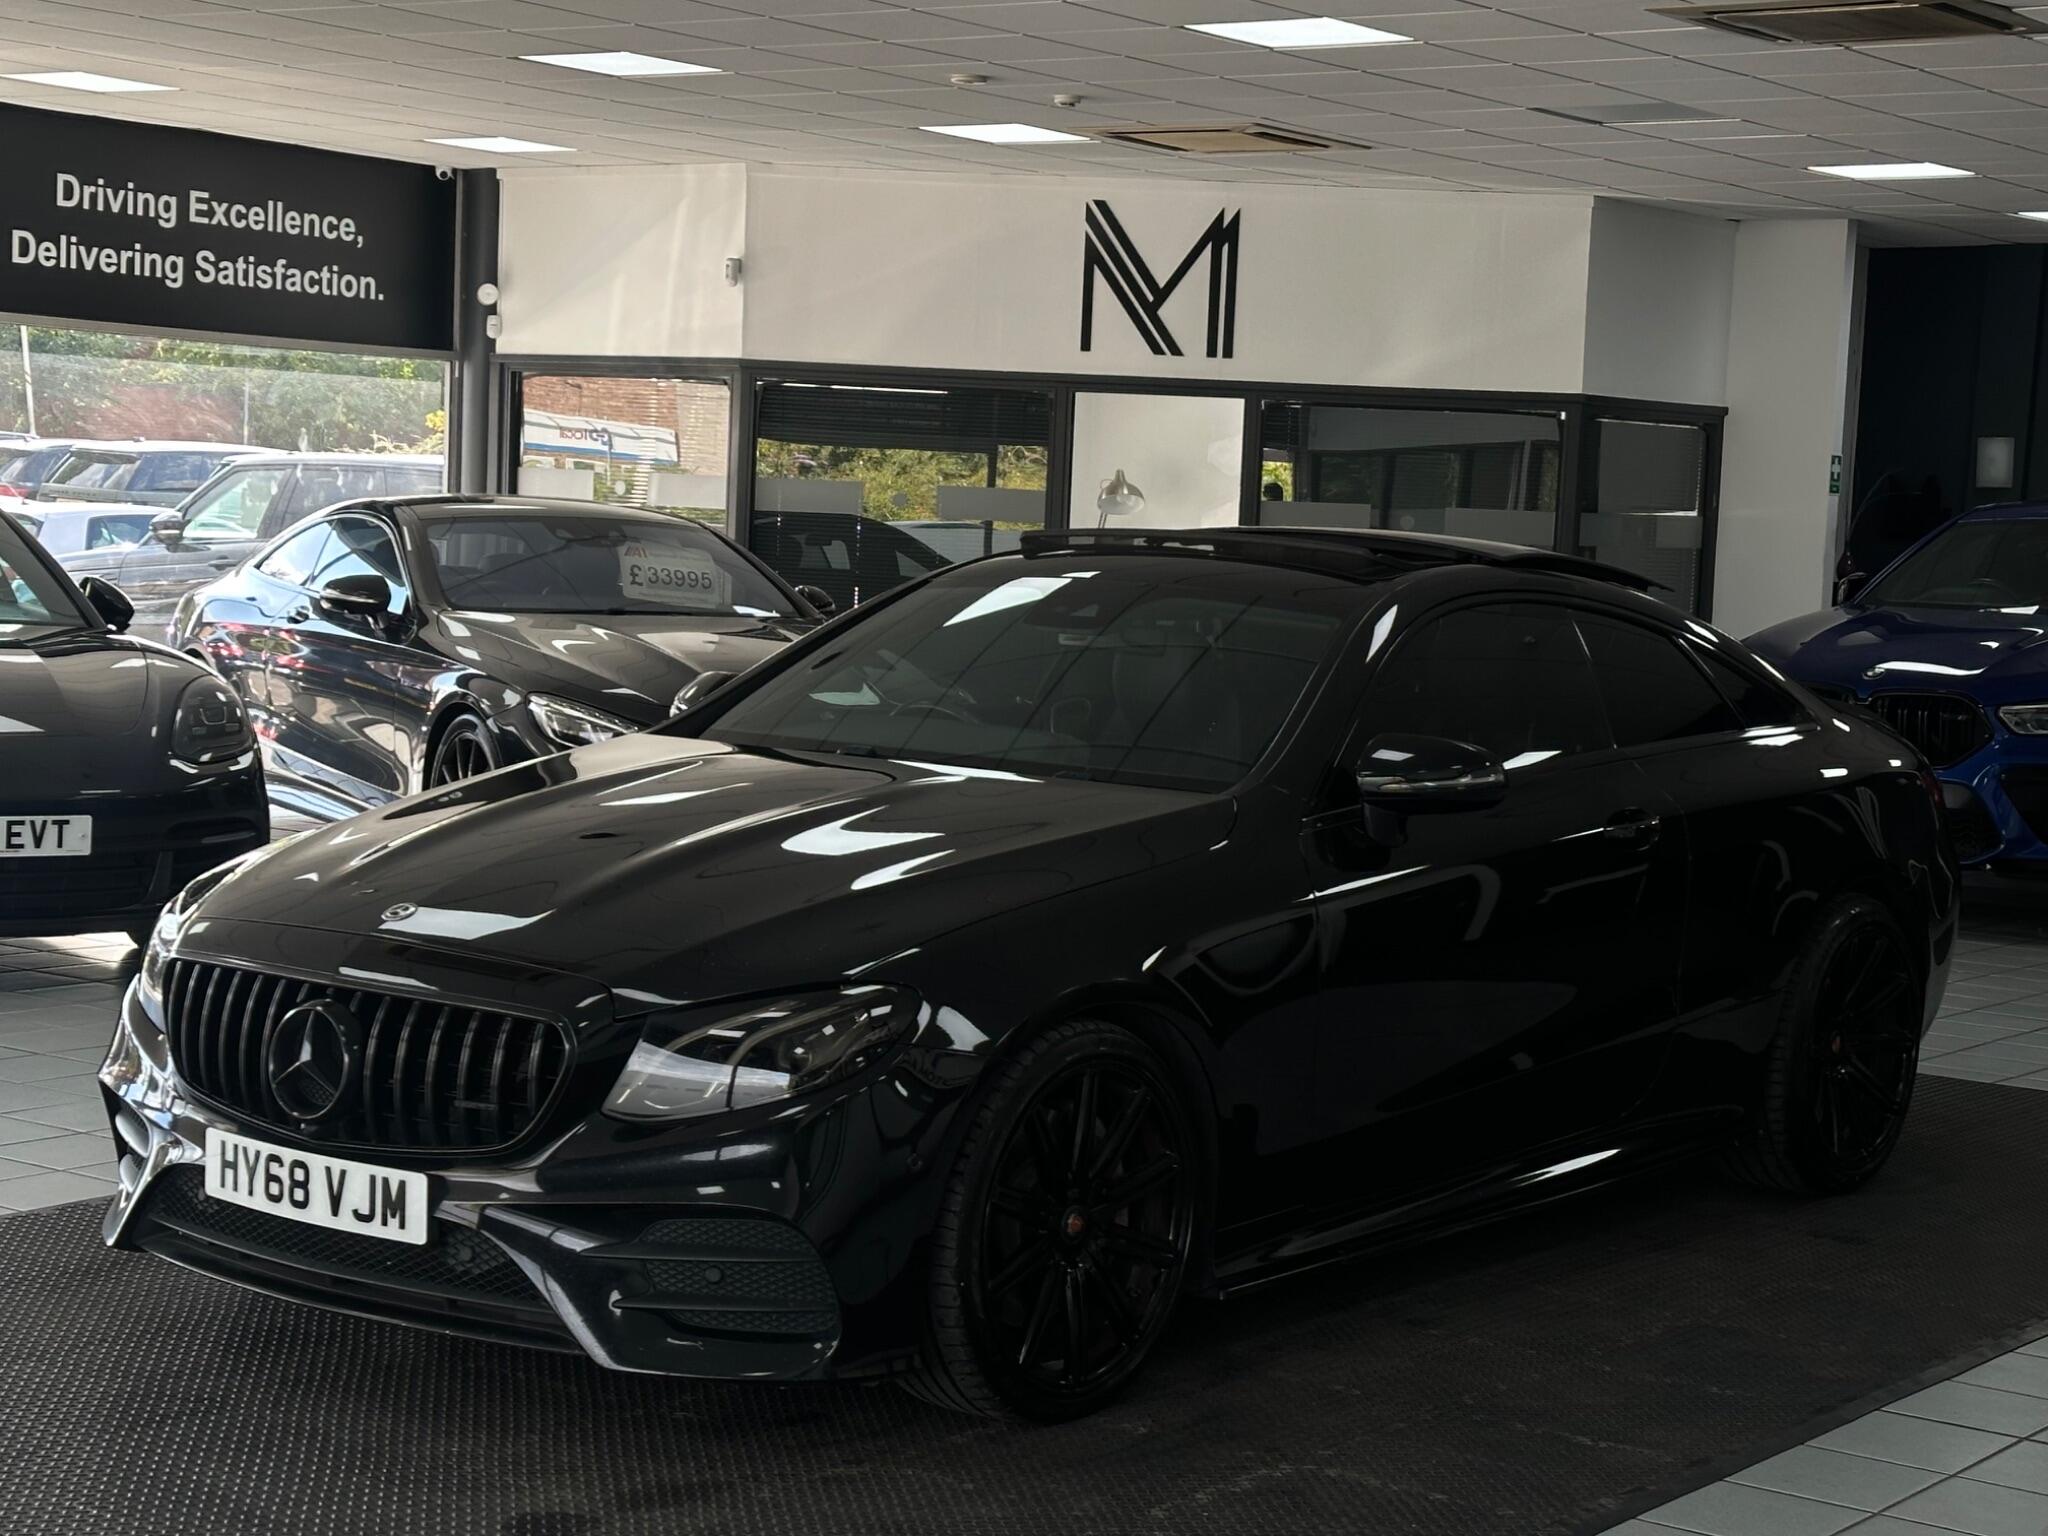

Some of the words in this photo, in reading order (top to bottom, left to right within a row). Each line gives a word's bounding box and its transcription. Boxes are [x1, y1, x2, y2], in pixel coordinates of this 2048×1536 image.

[56, 173, 177, 229] Driving
[189, 190, 364, 248] Excellence,
[11, 230, 184, 289] Delivering
[195, 250, 385, 301] Satisfaction.
[629, 564, 713, 592] £33995
[5, 819, 71, 850] EVT
[220, 1140, 311, 1211] HY68
[325, 1165, 407, 1231] VJM
